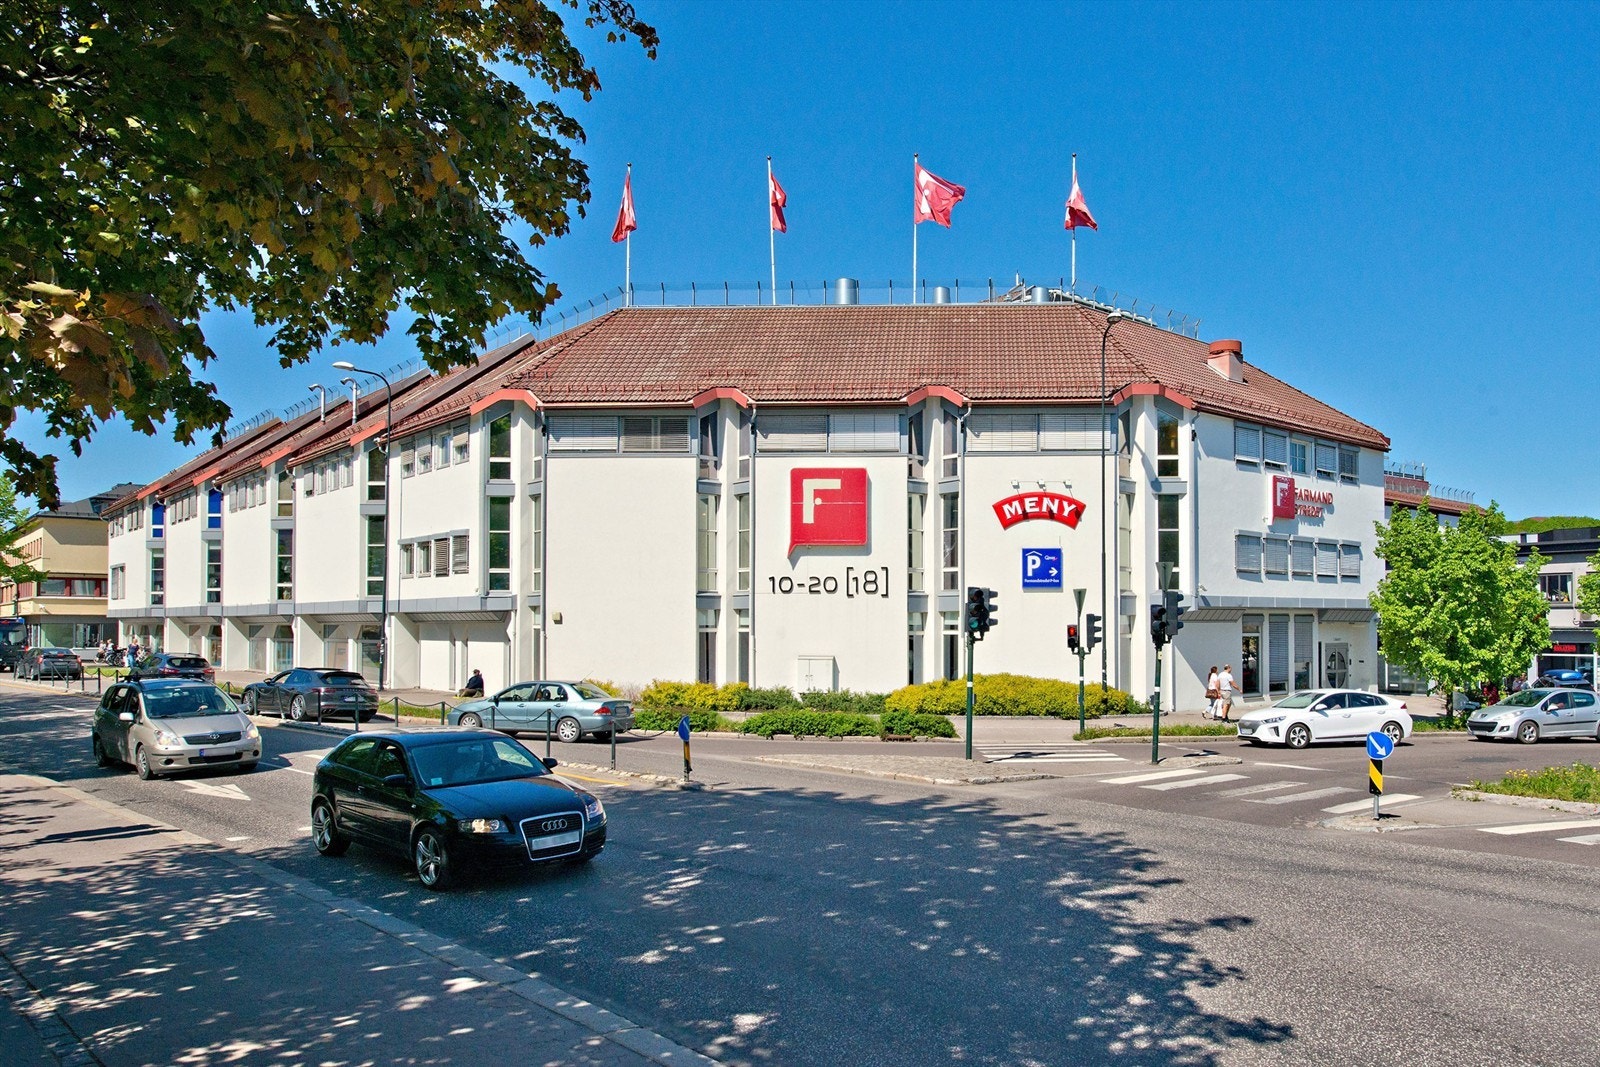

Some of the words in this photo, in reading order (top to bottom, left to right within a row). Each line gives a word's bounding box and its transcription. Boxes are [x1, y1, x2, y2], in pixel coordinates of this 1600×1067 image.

[802, 478, 842, 524] F
[1002, 497, 1077, 520] MENY
[1027, 555, 1041, 577] P
[768, 575, 839, 595] 10-20
[846, 566, 889, 599] [18]
